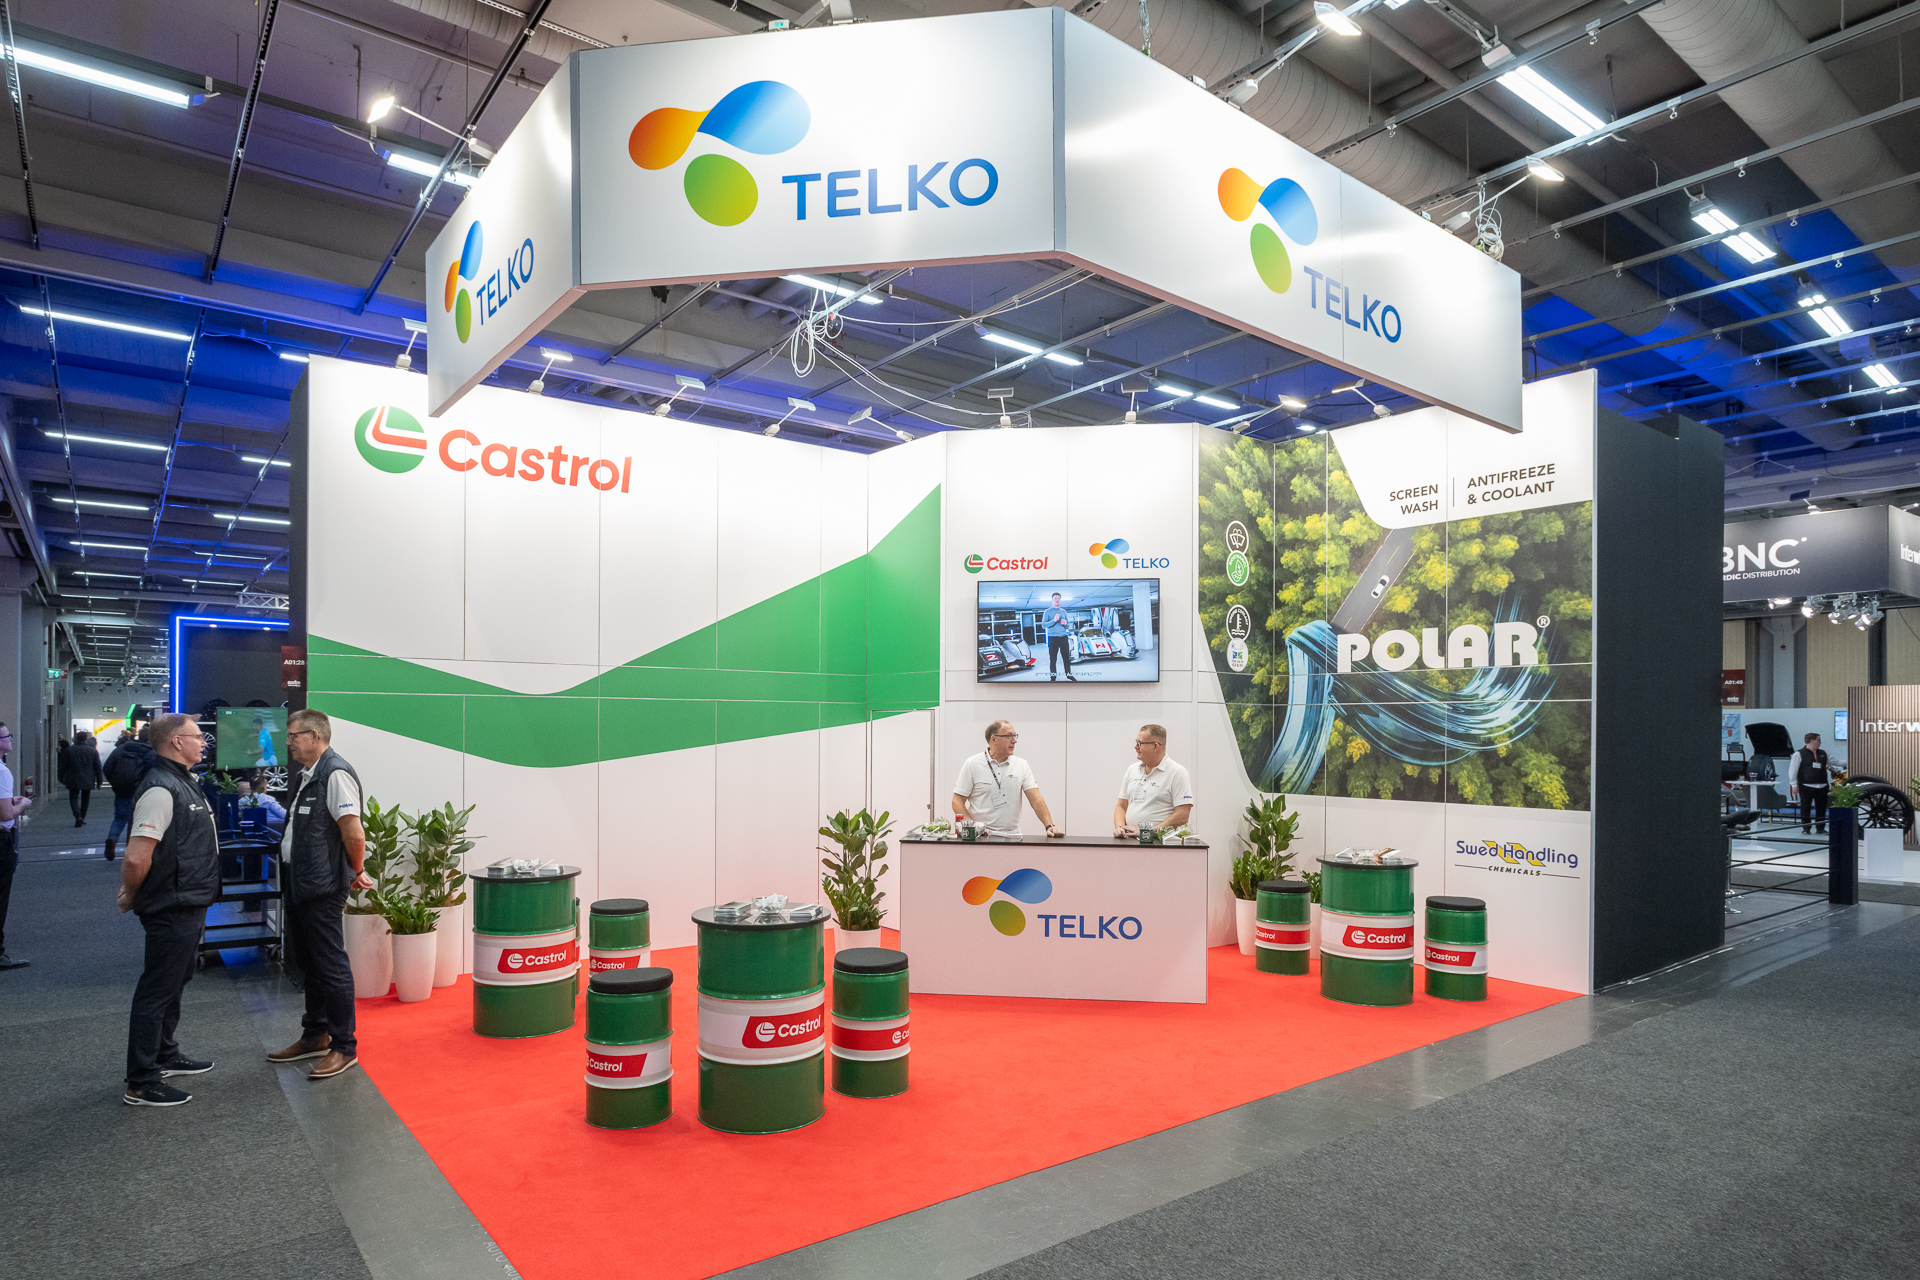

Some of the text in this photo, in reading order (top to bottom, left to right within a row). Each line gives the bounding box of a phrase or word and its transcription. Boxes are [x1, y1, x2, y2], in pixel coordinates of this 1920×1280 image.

[782, 158, 999, 221] TELKO
[476, 237, 534, 326] TELKO
[1303, 265, 1402, 343] TELKO
[438, 428, 633, 494] Castrol
[1467, 463, 1556, 489] ANTIFREEZE
[1389, 483, 1439, 502] SCREEN
[1467, 480, 1555, 505] & COOLANT
[1400, 499, 1439, 515] WASH
[986, 556, 1049, 571] Castrol
[1122, 557, 1170, 569] TELKO
[1742, 567, 1800, 580] DISTRIBUTION
[1488, 865, 1542, 876] CHEMICALS
[1037, 914, 1143, 940] TELKO
[1367, 933, 1406, 944] Castrol
[525, 949, 567, 967] Castrol
[597, 961, 626, 970] Castrol
[1431, 951, 1460, 963] Castrol
[777, 1014, 821, 1038] Castrol
[589, 1057, 623, 1072] Castrol
